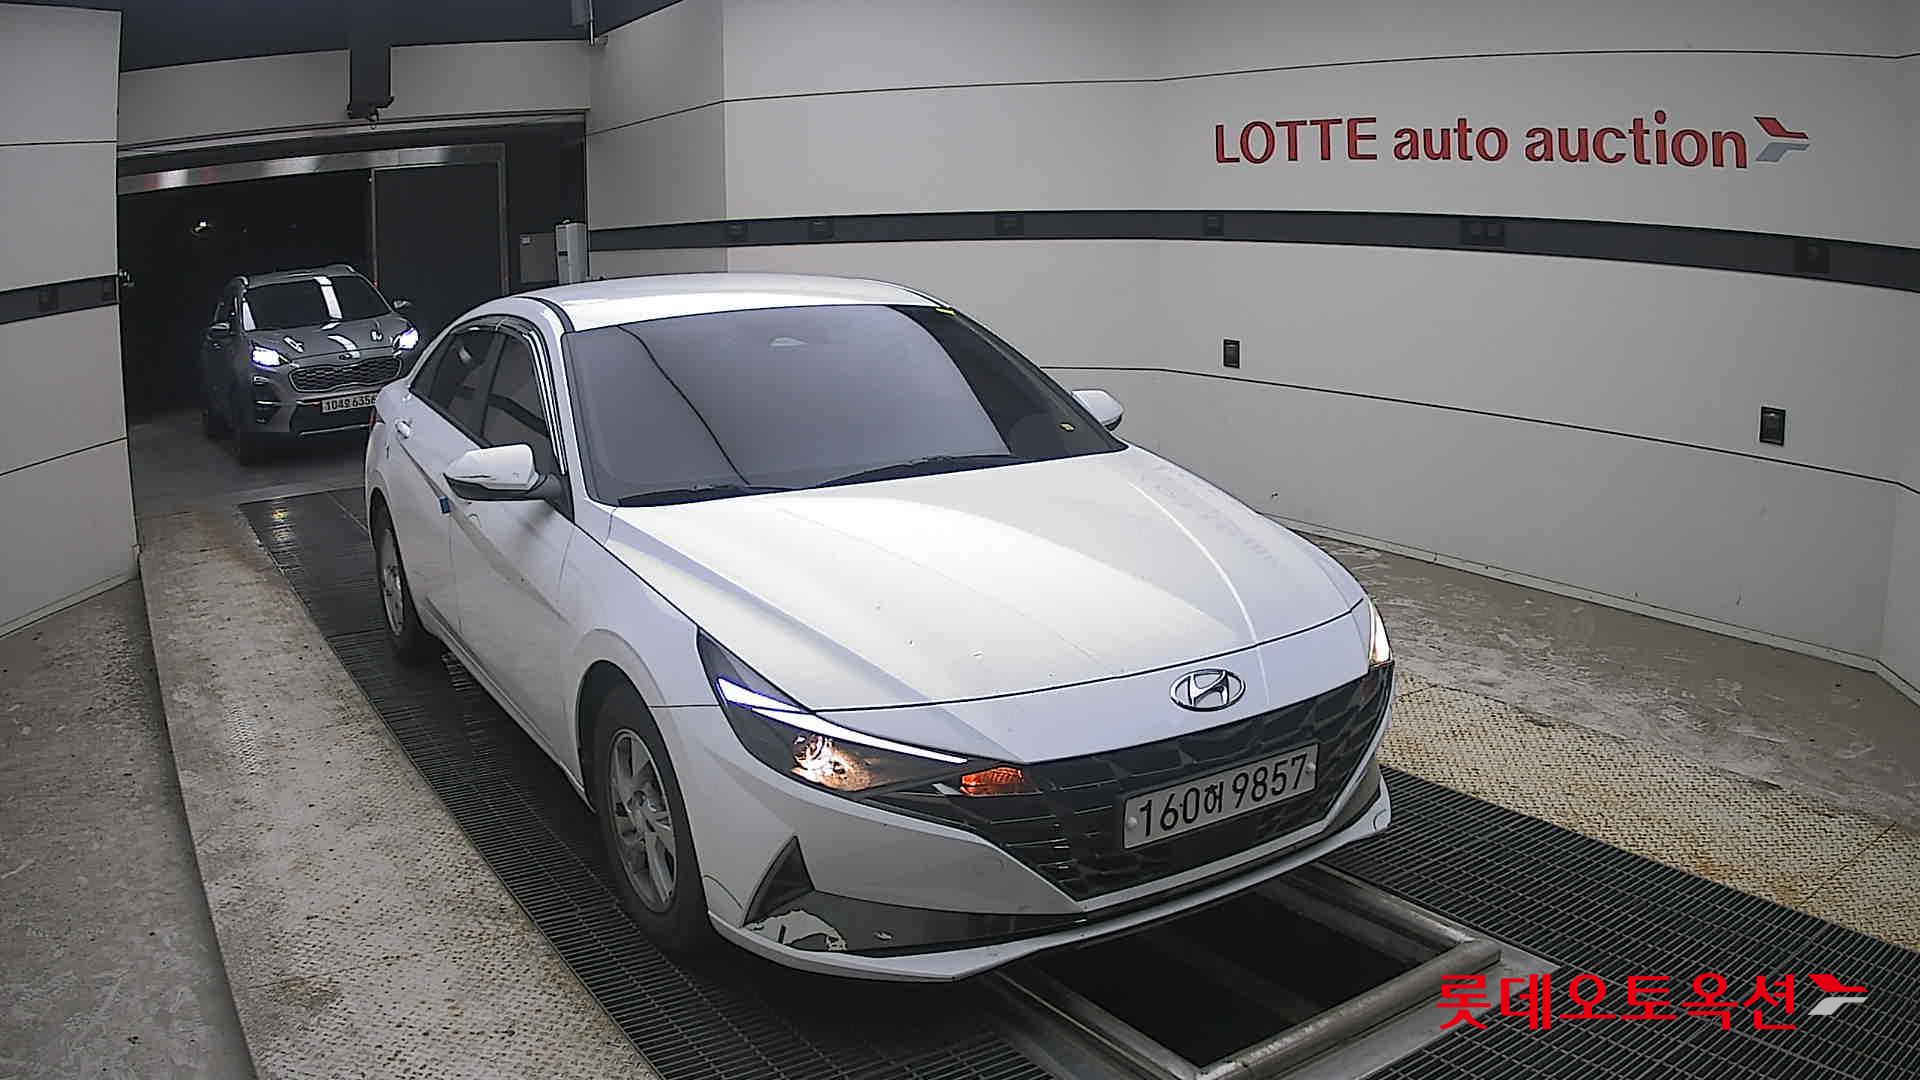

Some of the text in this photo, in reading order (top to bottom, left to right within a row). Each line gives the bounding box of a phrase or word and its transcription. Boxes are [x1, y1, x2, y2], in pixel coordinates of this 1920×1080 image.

[1215, 110, 1749, 170] LOTTE auto auction
[1139, 752, 1308, 837] 160허 9857
